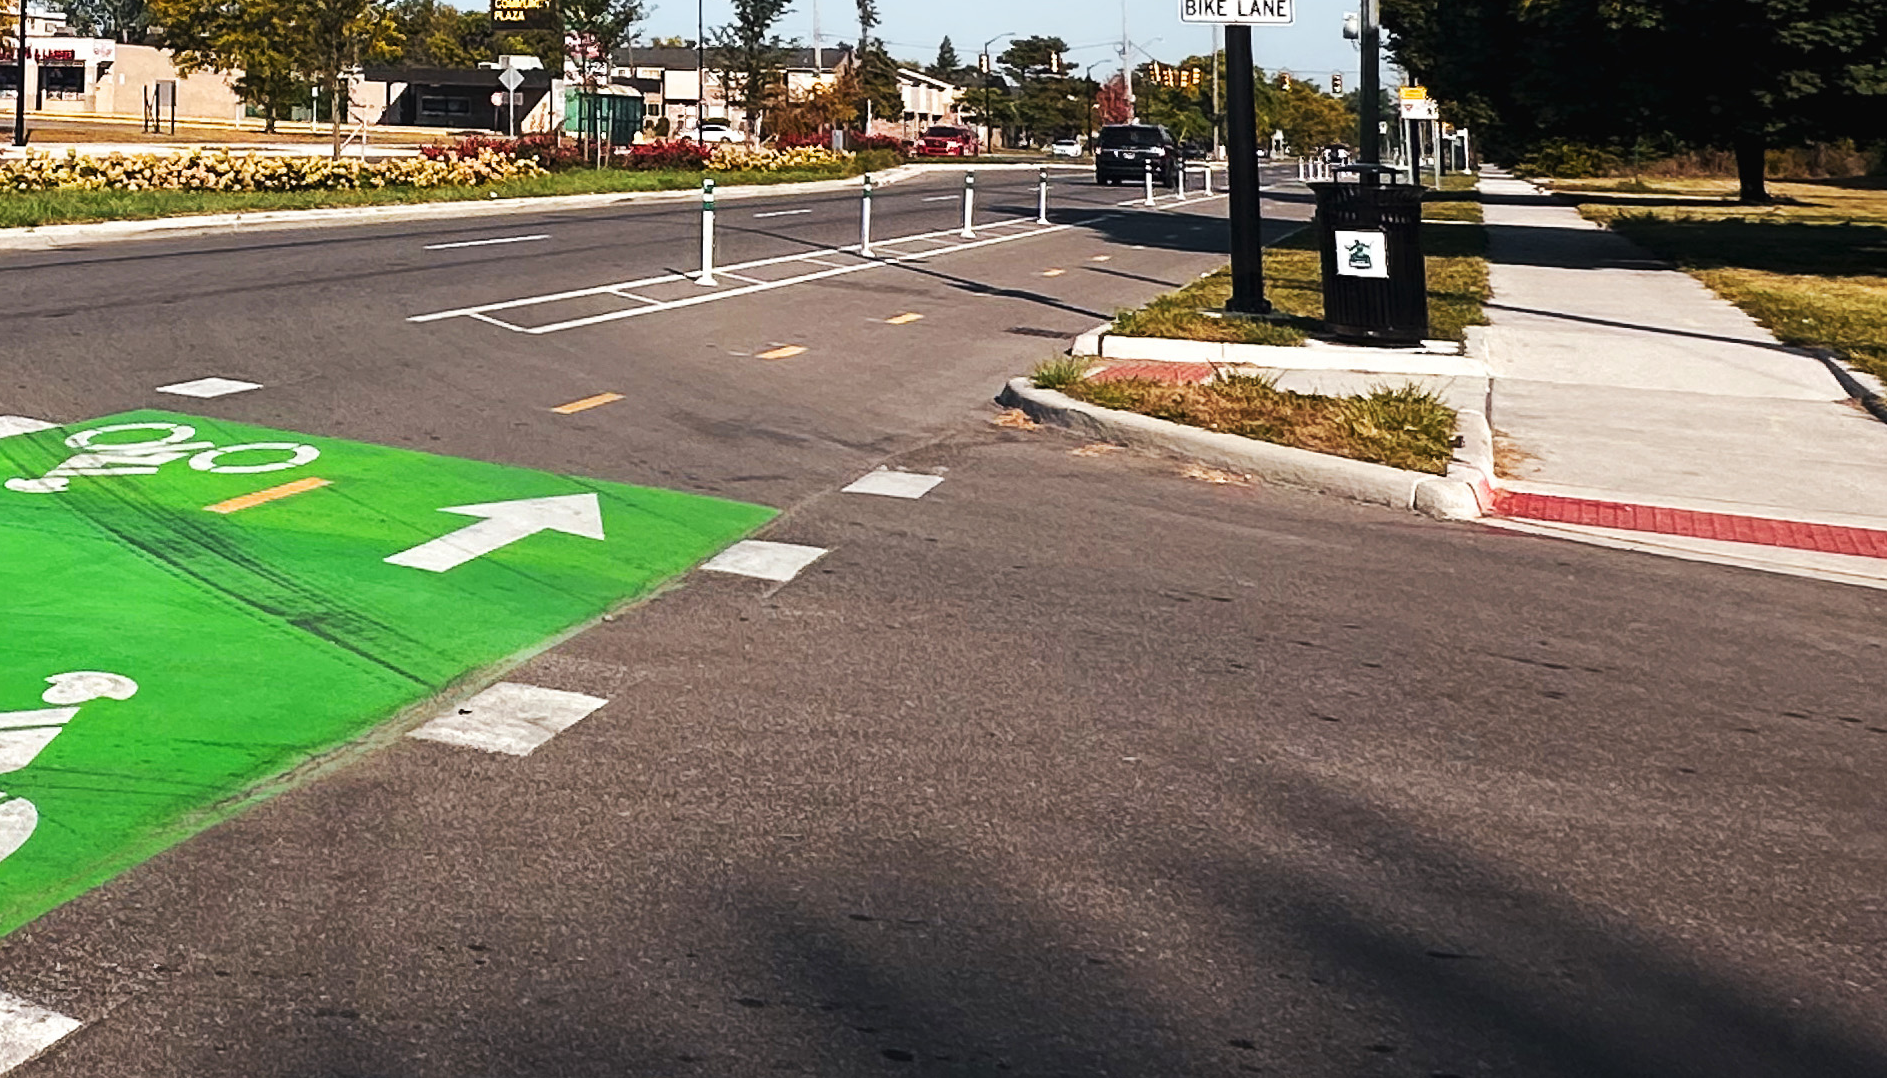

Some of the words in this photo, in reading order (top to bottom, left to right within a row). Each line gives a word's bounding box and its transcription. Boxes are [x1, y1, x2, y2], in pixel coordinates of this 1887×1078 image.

[494, 10, 526, 21] PLAZA
[1185, 0, 1228, 16] BIKE
[1237, 0, 1287, 17] LANE
